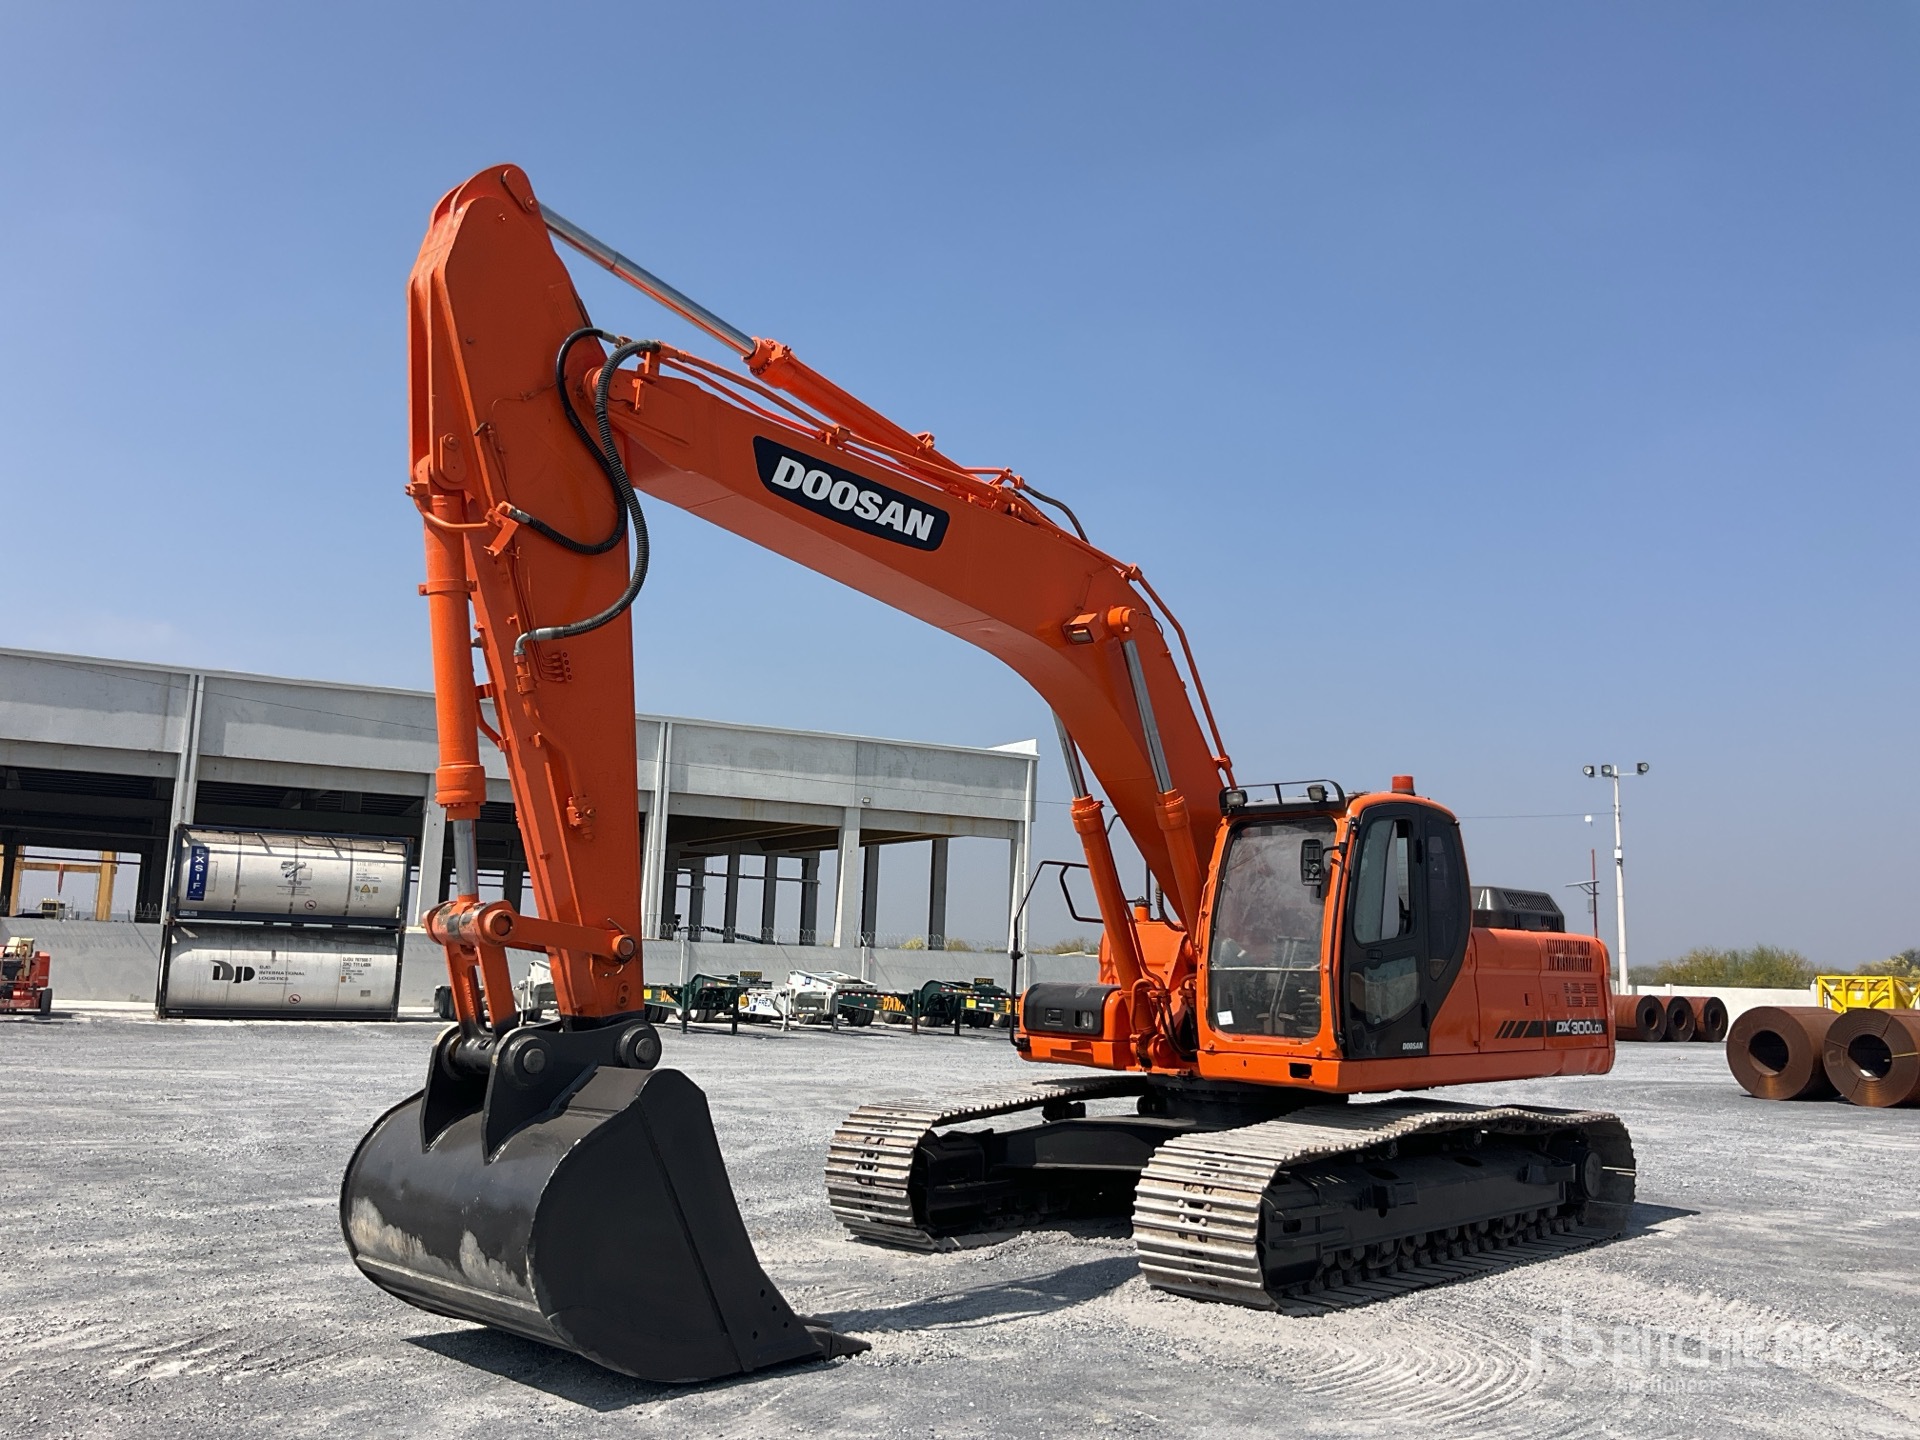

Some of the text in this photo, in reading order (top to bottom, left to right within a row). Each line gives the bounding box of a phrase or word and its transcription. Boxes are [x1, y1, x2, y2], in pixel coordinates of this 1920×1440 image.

[771, 455, 935, 541] DOOSAN
[192, 848, 205, 889] EXSIF
[1402, 1041, 1423, 1050] DOOSAN
